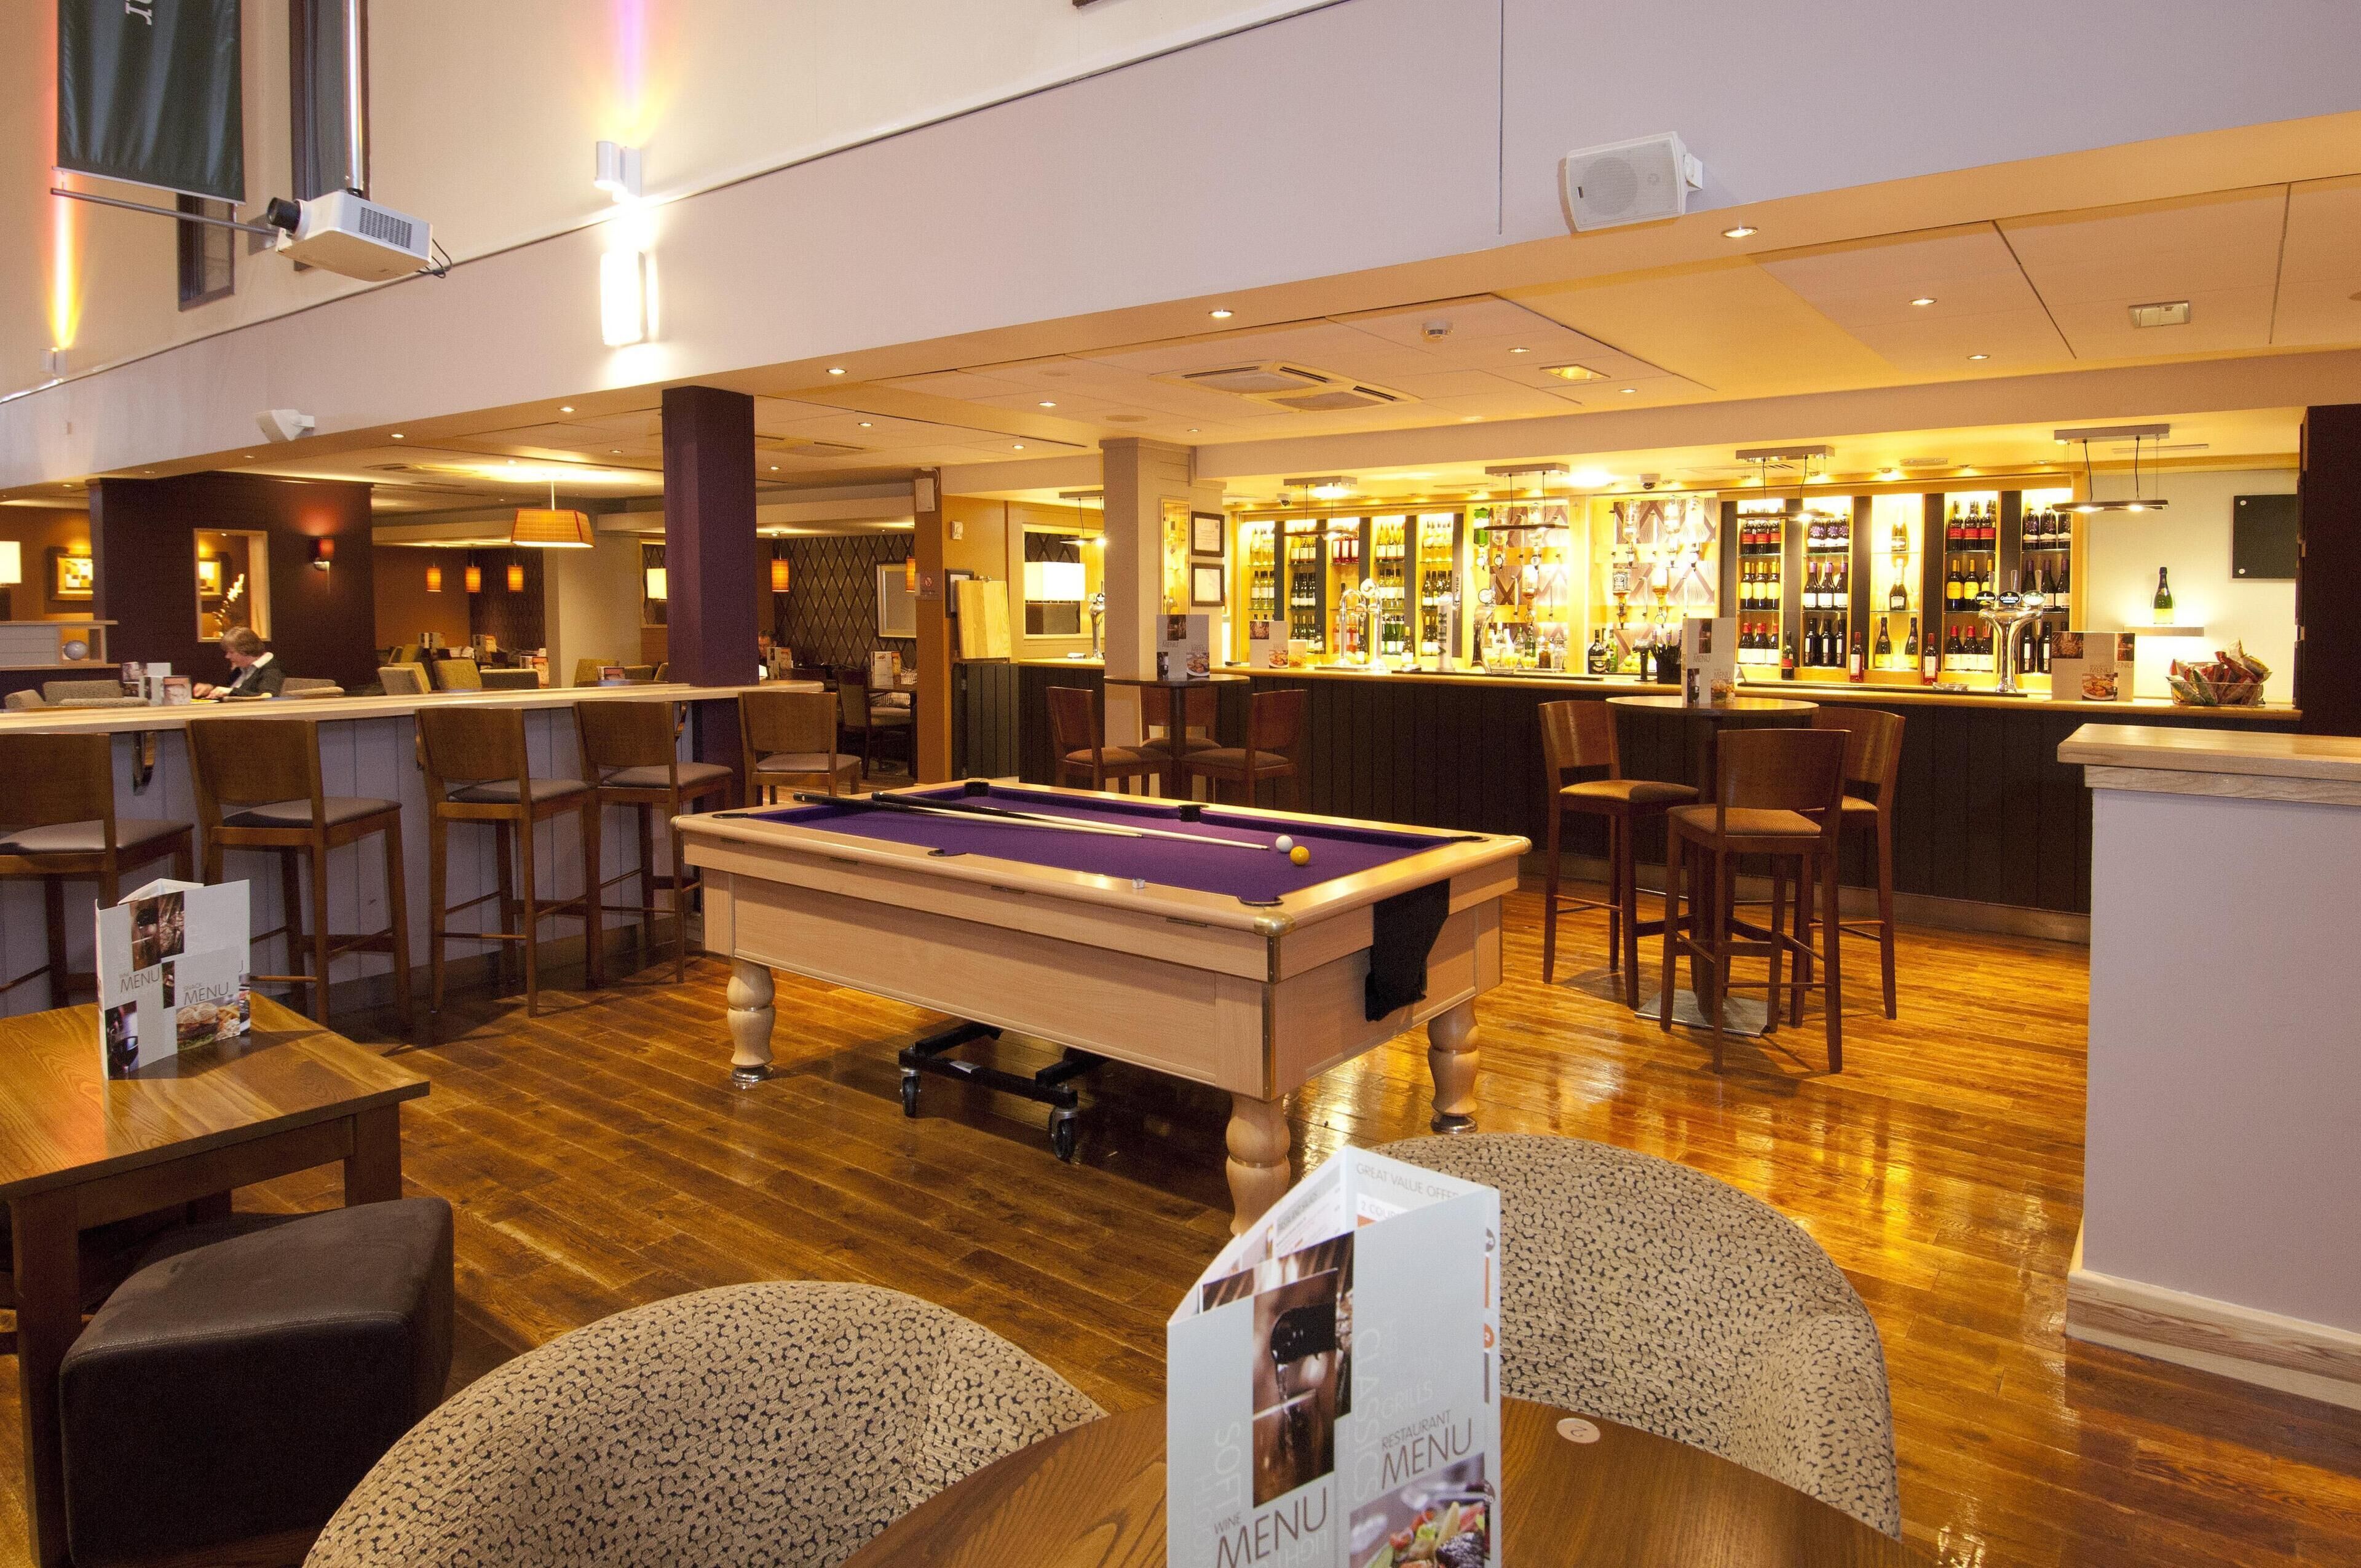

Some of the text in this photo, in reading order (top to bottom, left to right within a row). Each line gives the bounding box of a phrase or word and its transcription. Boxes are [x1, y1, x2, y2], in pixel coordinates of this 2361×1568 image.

[121, 967, 160, 993] MENU
[184, 982, 229, 1005] MENU
[1356, 1163, 1388, 1182] GREAT
[1391, 1173, 1423, 1195] VALUE
[1361, 1200, 1367, 1211] 2
[1382, 1410, 1451, 1449] RESTAURANT
[1382, 1417, 1472, 1490] MENU
[1216, 1486, 1327, 1568] MENU
